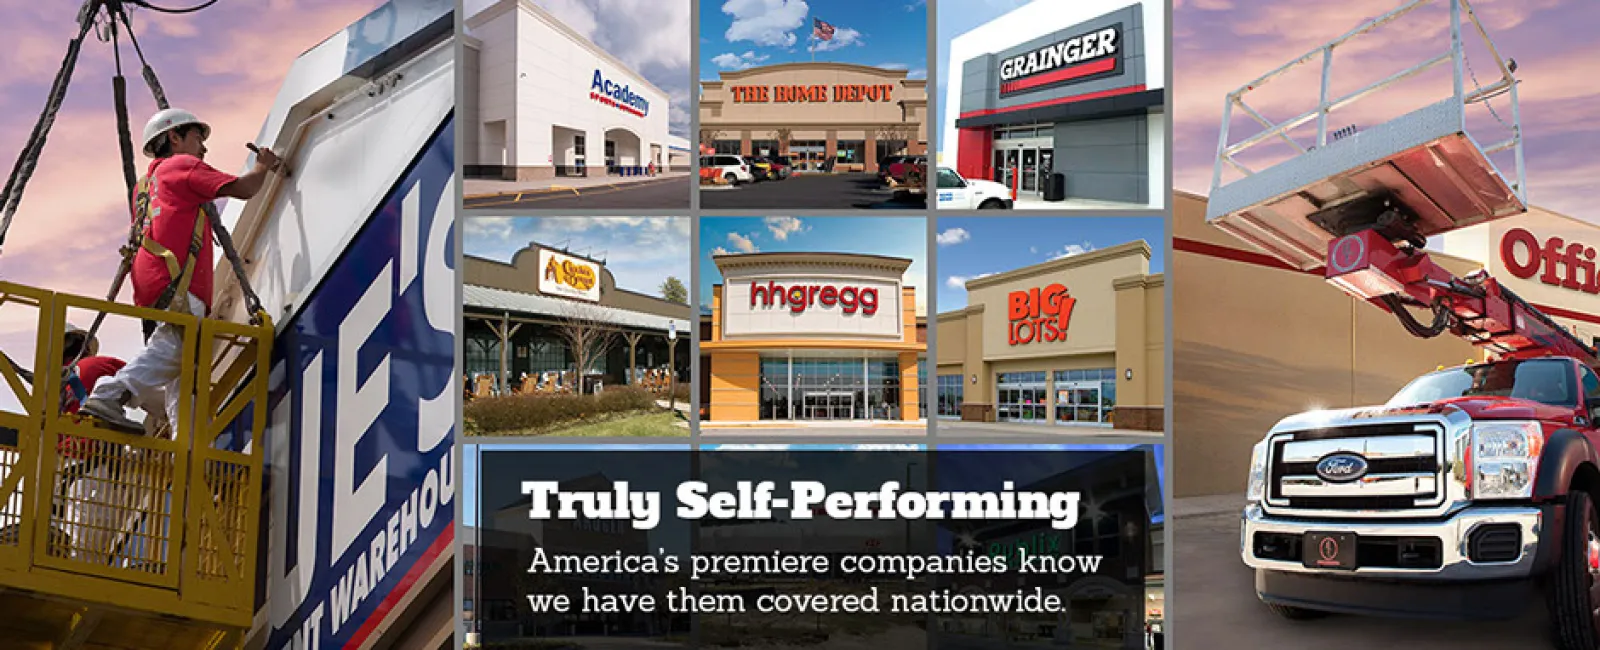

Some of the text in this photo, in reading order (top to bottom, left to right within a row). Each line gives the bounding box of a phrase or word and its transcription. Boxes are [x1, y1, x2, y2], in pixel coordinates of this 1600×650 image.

[1000, 28, 1117, 81] GRAINGER
[591, 69, 649, 116] Academy
[731, 84, 894, 104] THE HOME DEPOT
[1500, 228, 1600, 295] Offi
[751, 280, 878, 316] hhgregg
[1008, 283, 1067, 322] BIG
[1324, 460, 1355, 475] Ford
